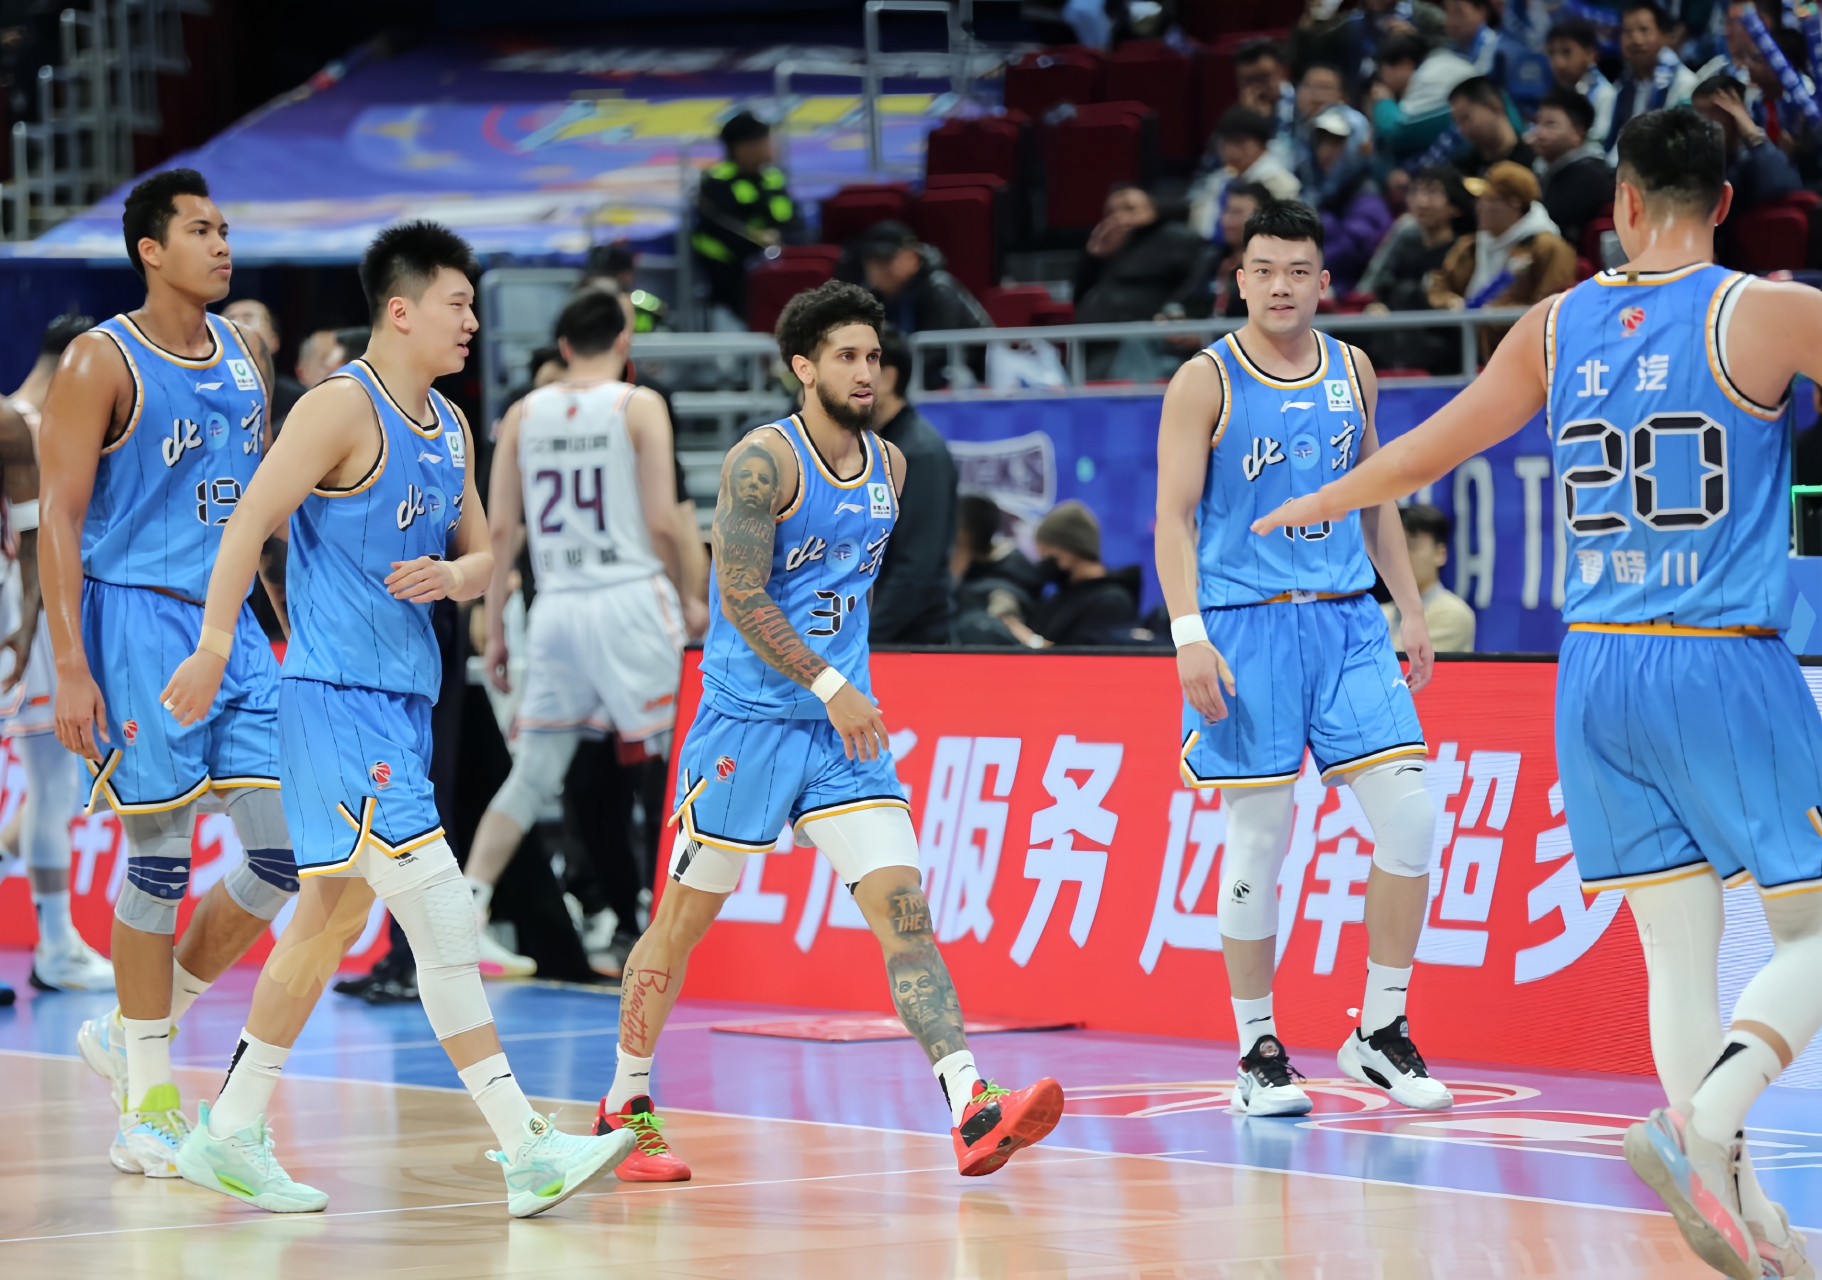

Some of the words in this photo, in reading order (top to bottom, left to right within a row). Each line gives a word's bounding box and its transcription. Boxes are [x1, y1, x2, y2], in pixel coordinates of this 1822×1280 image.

[1242, 420, 1356, 482] 北京
[1557, 411, 1729, 537] 20
[535, 467, 606, 534] 24
[785, 527, 890, 576] 北京
